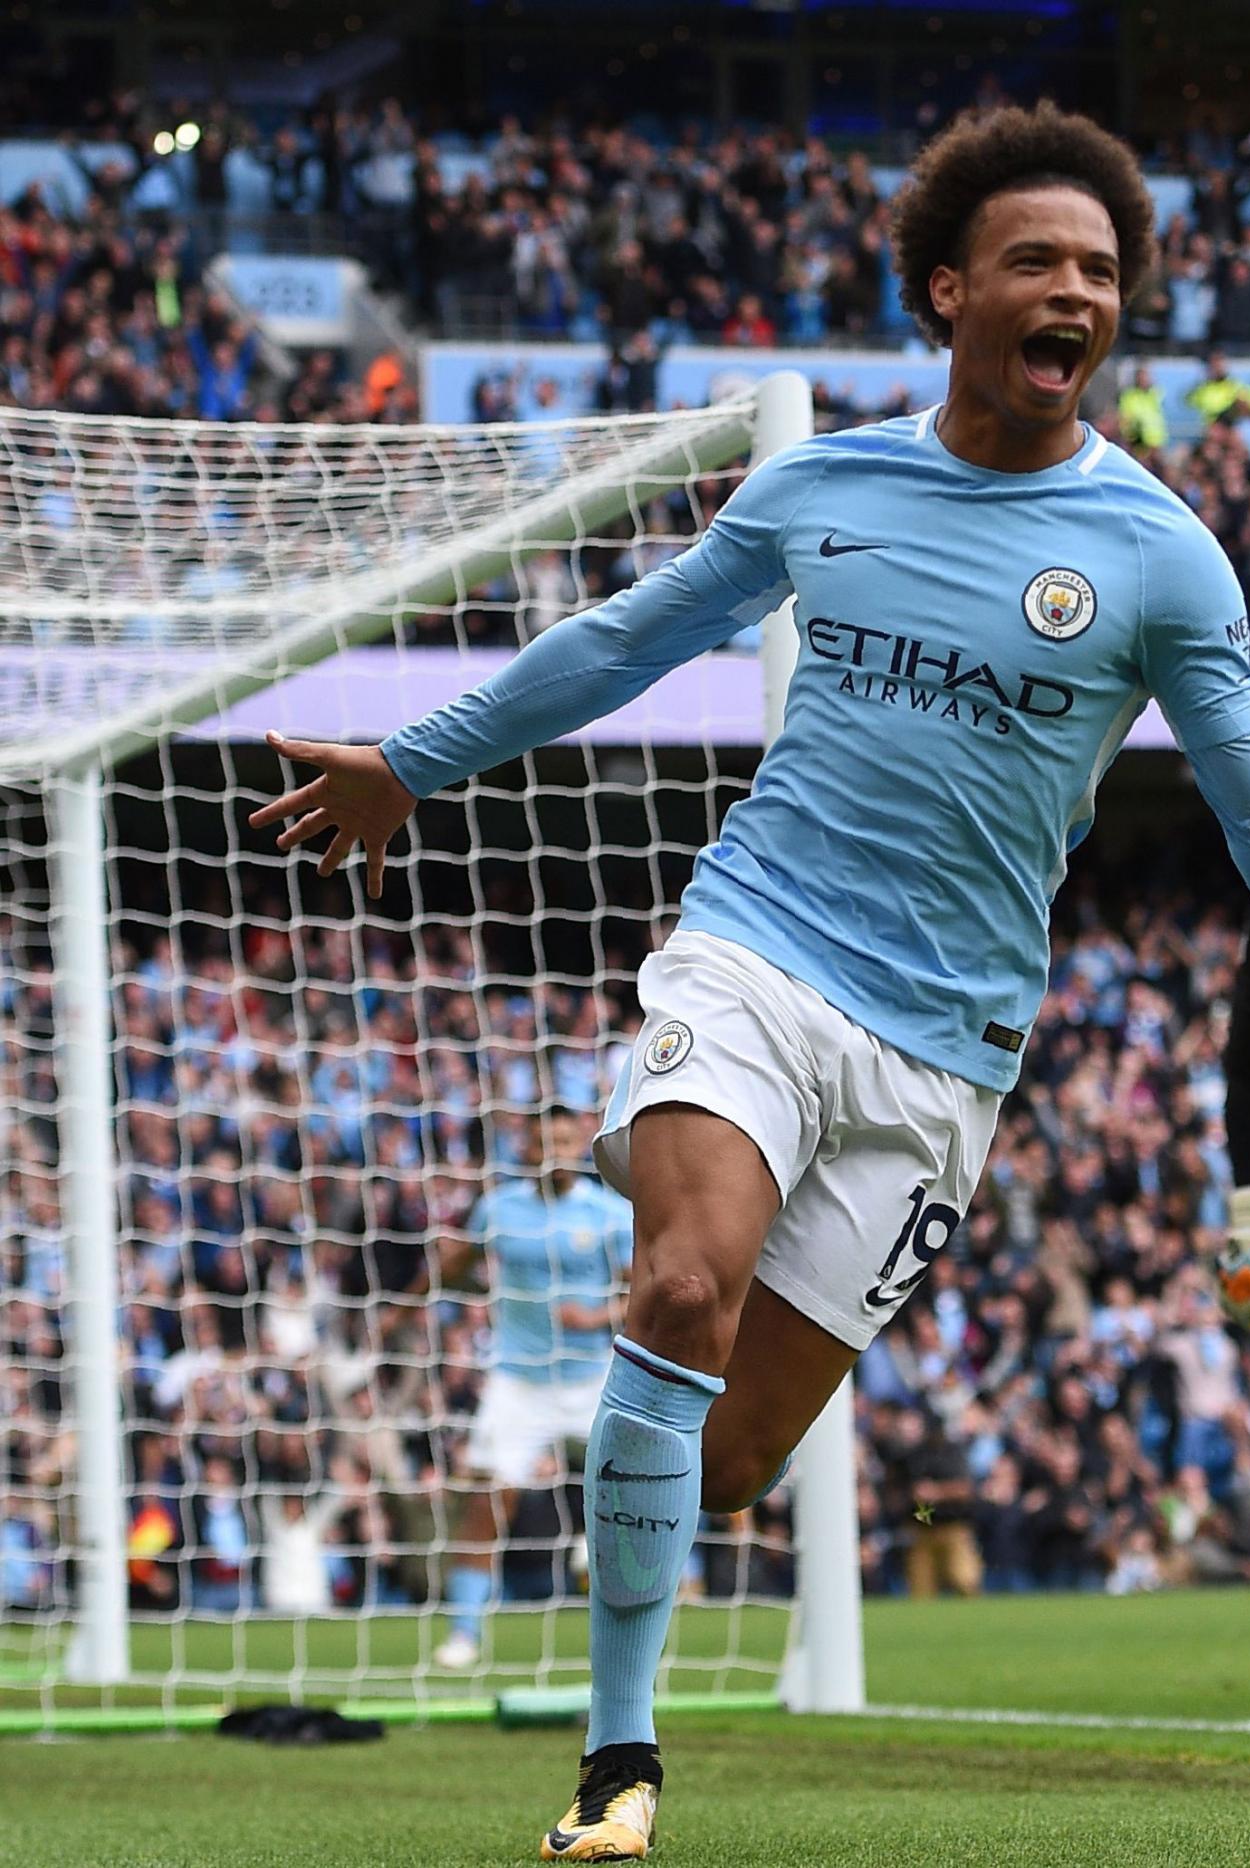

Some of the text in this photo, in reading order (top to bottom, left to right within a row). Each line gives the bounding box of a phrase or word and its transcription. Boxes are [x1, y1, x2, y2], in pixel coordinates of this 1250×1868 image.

[1036, 572, 1091, 603] MANCHESTER
[1041, 624, 1063, 637] CITY
[1225, 616, 1250, 646] NE
[807, 617, 1074, 718] ETIHAD
[838, 671, 1012, 735] AIRWAYS
[879, 1184, 961, 1291] 19
